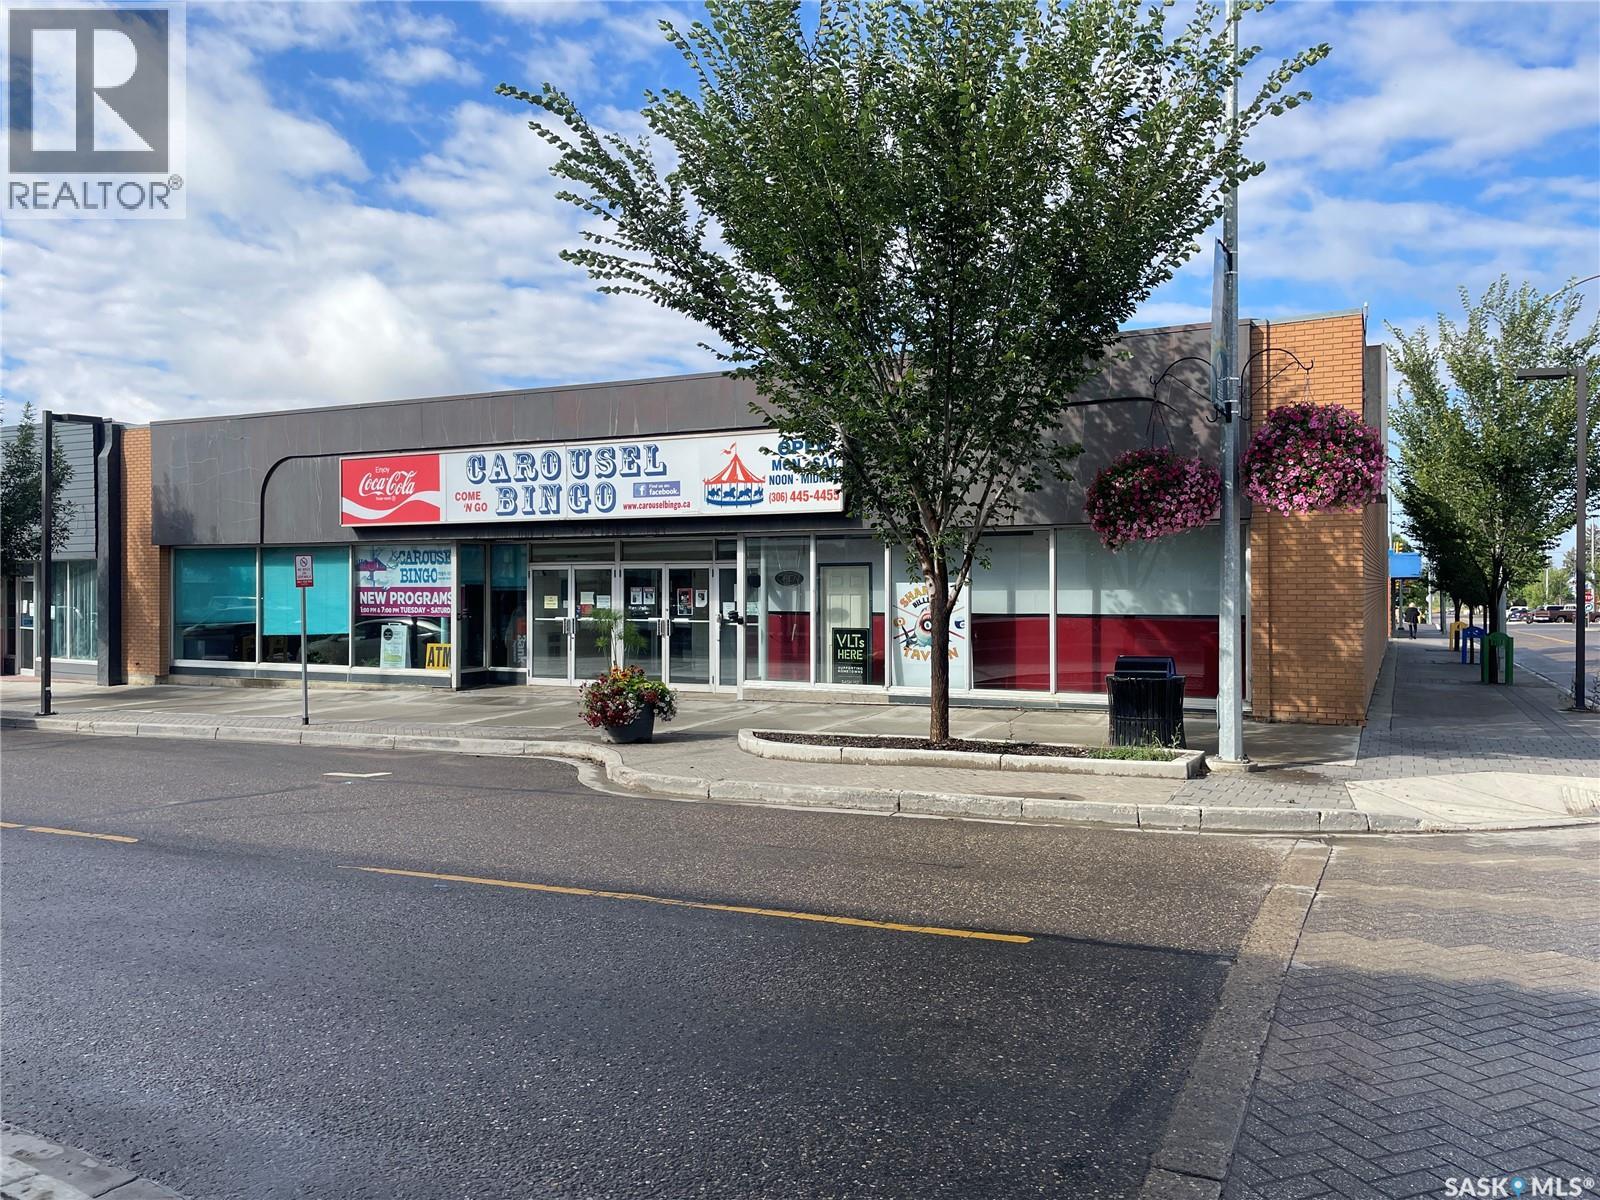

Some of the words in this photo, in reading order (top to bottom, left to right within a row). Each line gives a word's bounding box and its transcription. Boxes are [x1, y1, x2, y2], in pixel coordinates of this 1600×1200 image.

[466, 444, 667, 485] CAROUSEL
[769, 474, 794, 485] NOON
[454, 491, 481, 501] COME
[496, 481, 617, 516] BINGO
[769, 491, 788, 504] (306)
[789, 488, 840, 502] 445-4455
[474, 502, 488, 512] GO
[623, 500, 691, 511] www.carouselbingo.ca
[400, 567, 438, 583] BINGO
[360, 591, 387, 604] NEW
[836, 633, 865, 648] VLTs
[427, 646, 451, 667] ATM
[837, 649, 863, 660] HERE
[903, 646, 959, 661] TAVN
